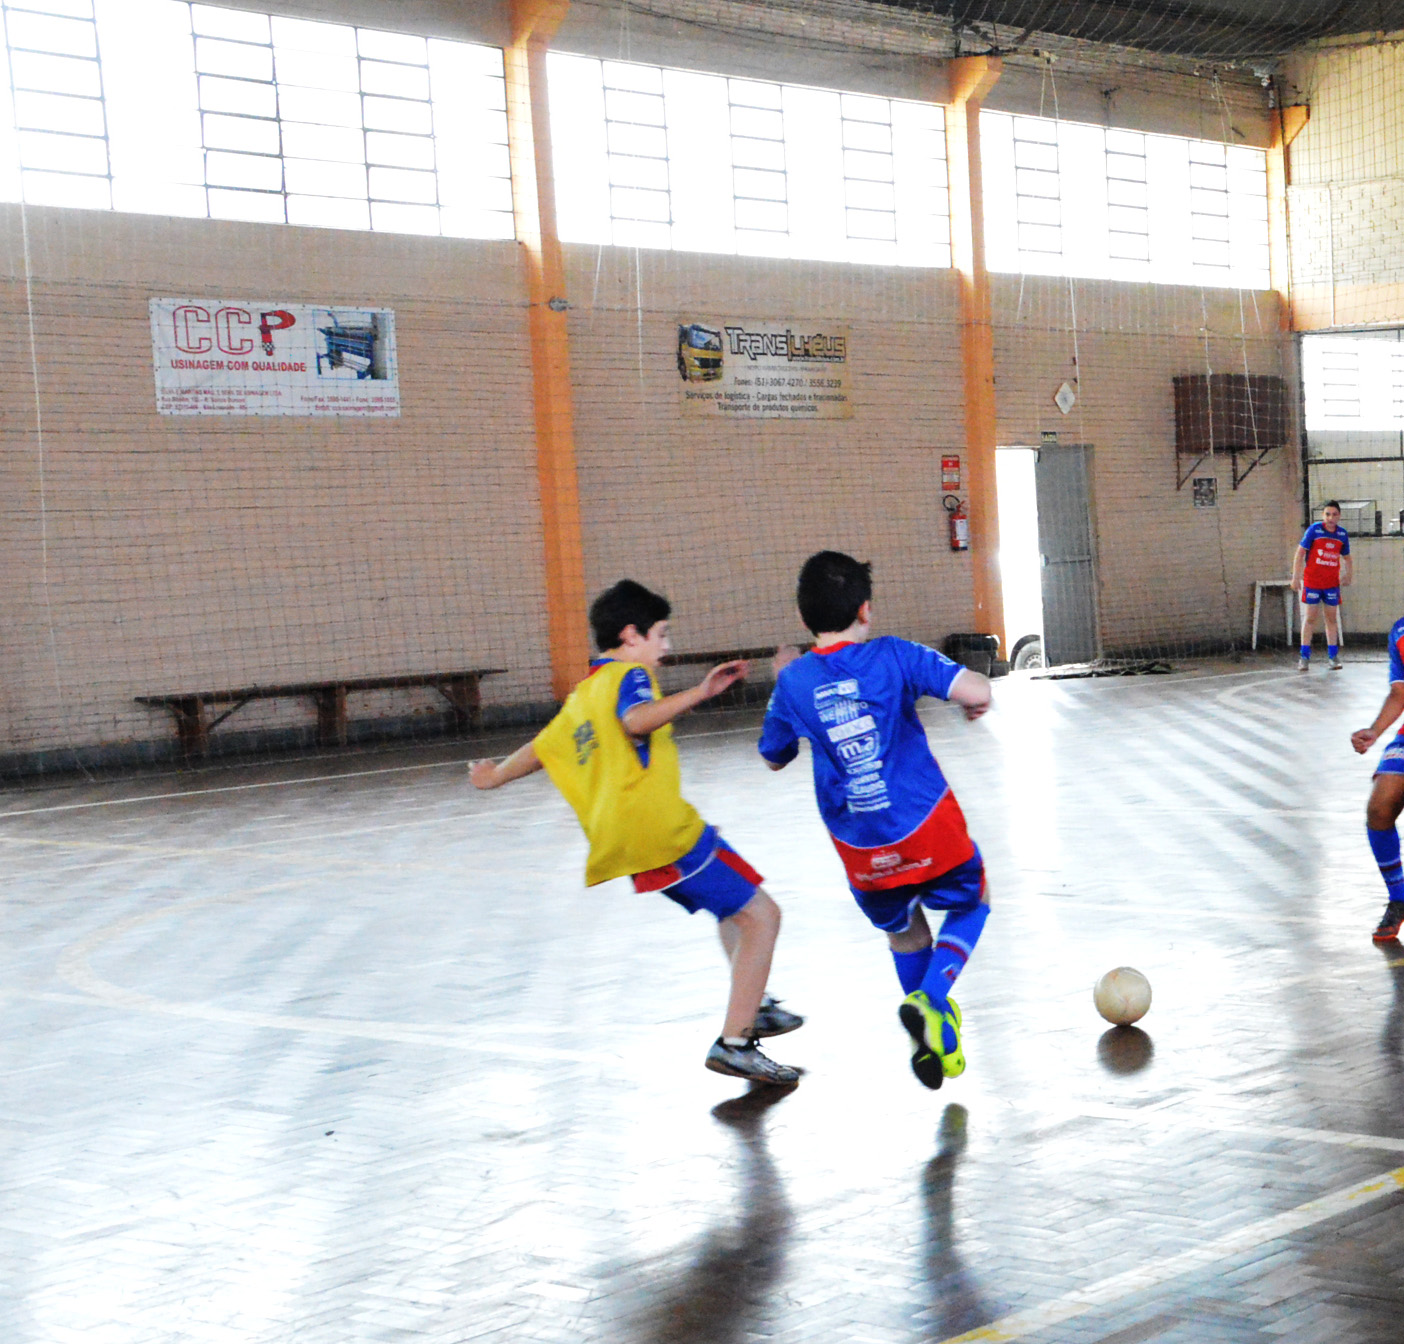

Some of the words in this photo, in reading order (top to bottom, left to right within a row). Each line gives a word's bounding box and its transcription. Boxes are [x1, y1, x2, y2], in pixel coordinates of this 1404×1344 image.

[172, 305, 296, 356] CCP
[171, 360, 224, 370] USINAGEM
[227, 361, 249, 371] COM
[252, 361, 306, 372] QUALIDADE
